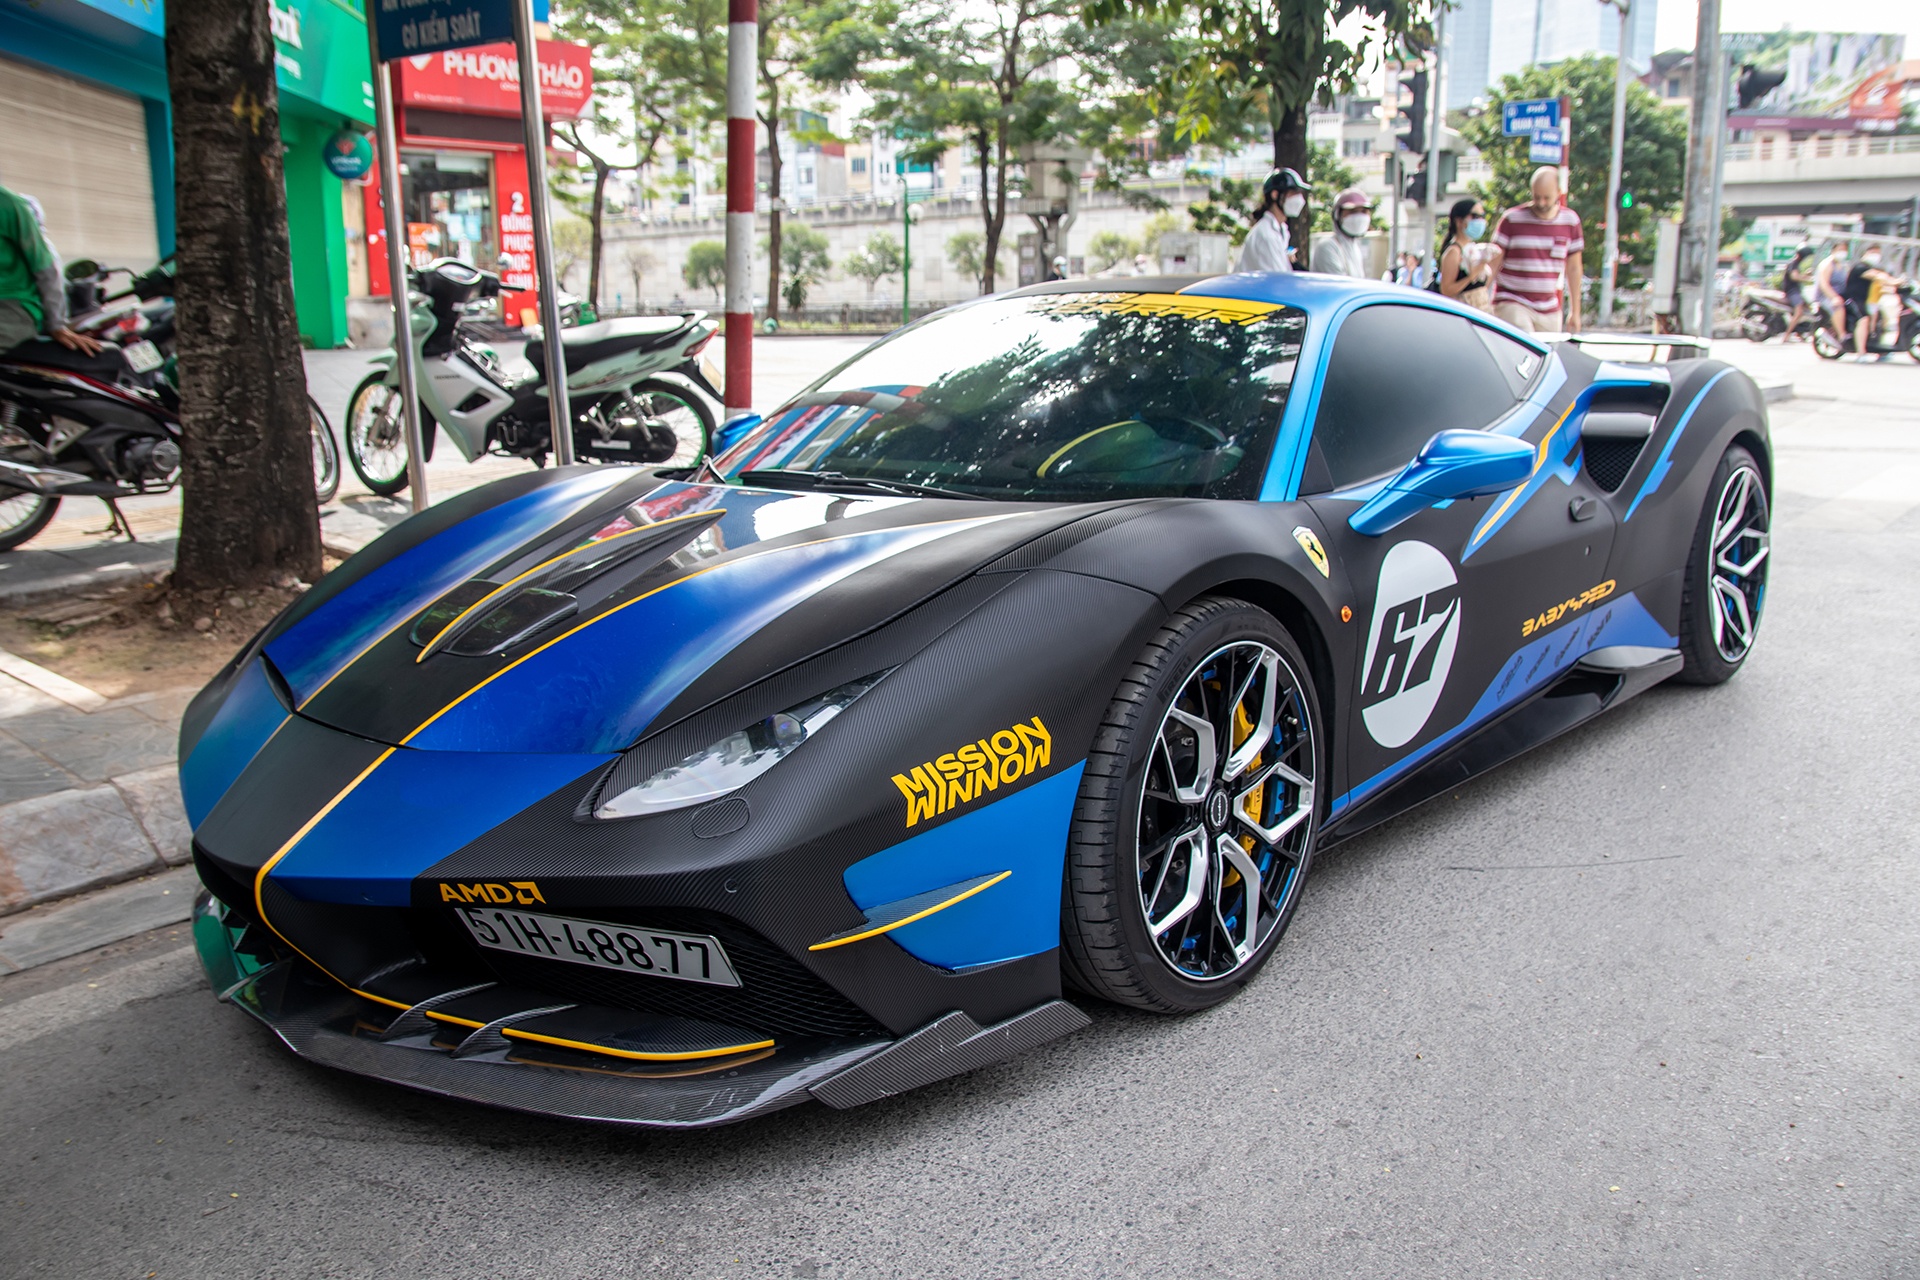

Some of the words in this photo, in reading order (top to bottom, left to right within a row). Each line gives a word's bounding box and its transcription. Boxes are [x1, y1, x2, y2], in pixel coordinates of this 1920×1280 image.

[402, 18, 419, 49] CÓ
[420, 9, 450, 46] KIỂM
[450, 7, 481, 41] SOÁT
[511, 191, 525, 213] 2
[1363, 584, 1461, 705] 67
[891, 716, 1052, 799] MISSION
[906, 738, 1052, 828] WINNOW
[439, 883, 514, 904] AMD
[466, 908, 711, 979] 51H-488.77
